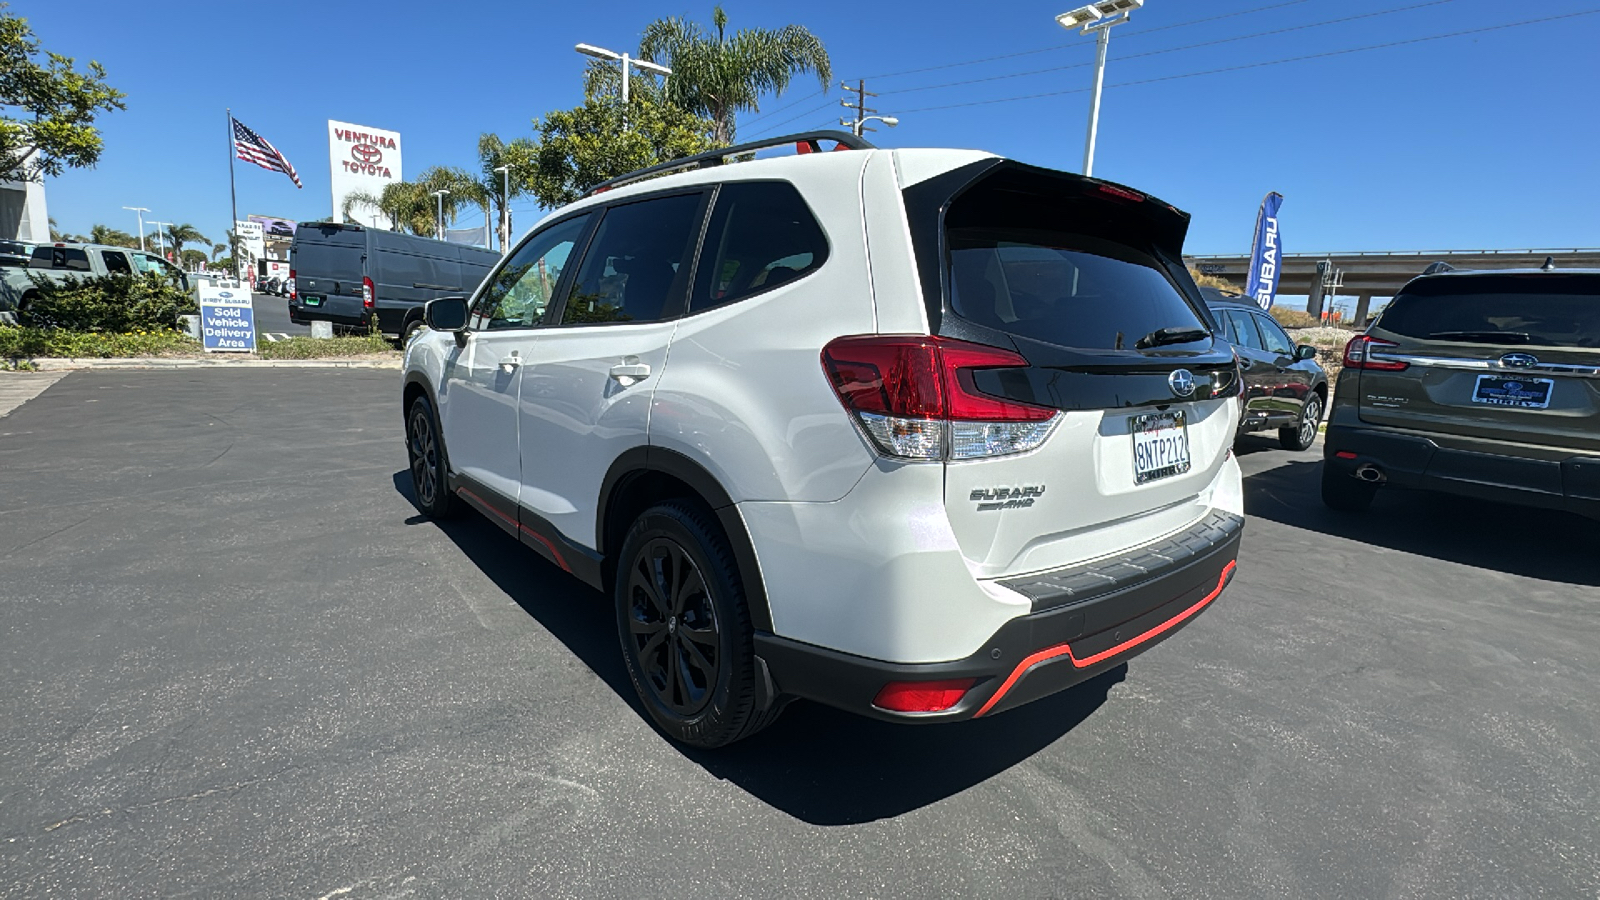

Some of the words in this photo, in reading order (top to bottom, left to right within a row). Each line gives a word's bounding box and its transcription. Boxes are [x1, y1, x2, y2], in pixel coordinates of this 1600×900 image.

[334, 128, 396, 150] VENTURA
[342, 160, 392, 179] TOYOTA
[1257, 217, 1278, 311] SUBARU
[214, 307, 241, 318] Sold
[207, 317, 249, 328] Vehicle
[205, 327, 252, 339] Delivery
[218, 338, 246, 348] Area
[1136, 434, 1186, 471] 8NTP212
[969, 484, 1046, 501] SUBARU
